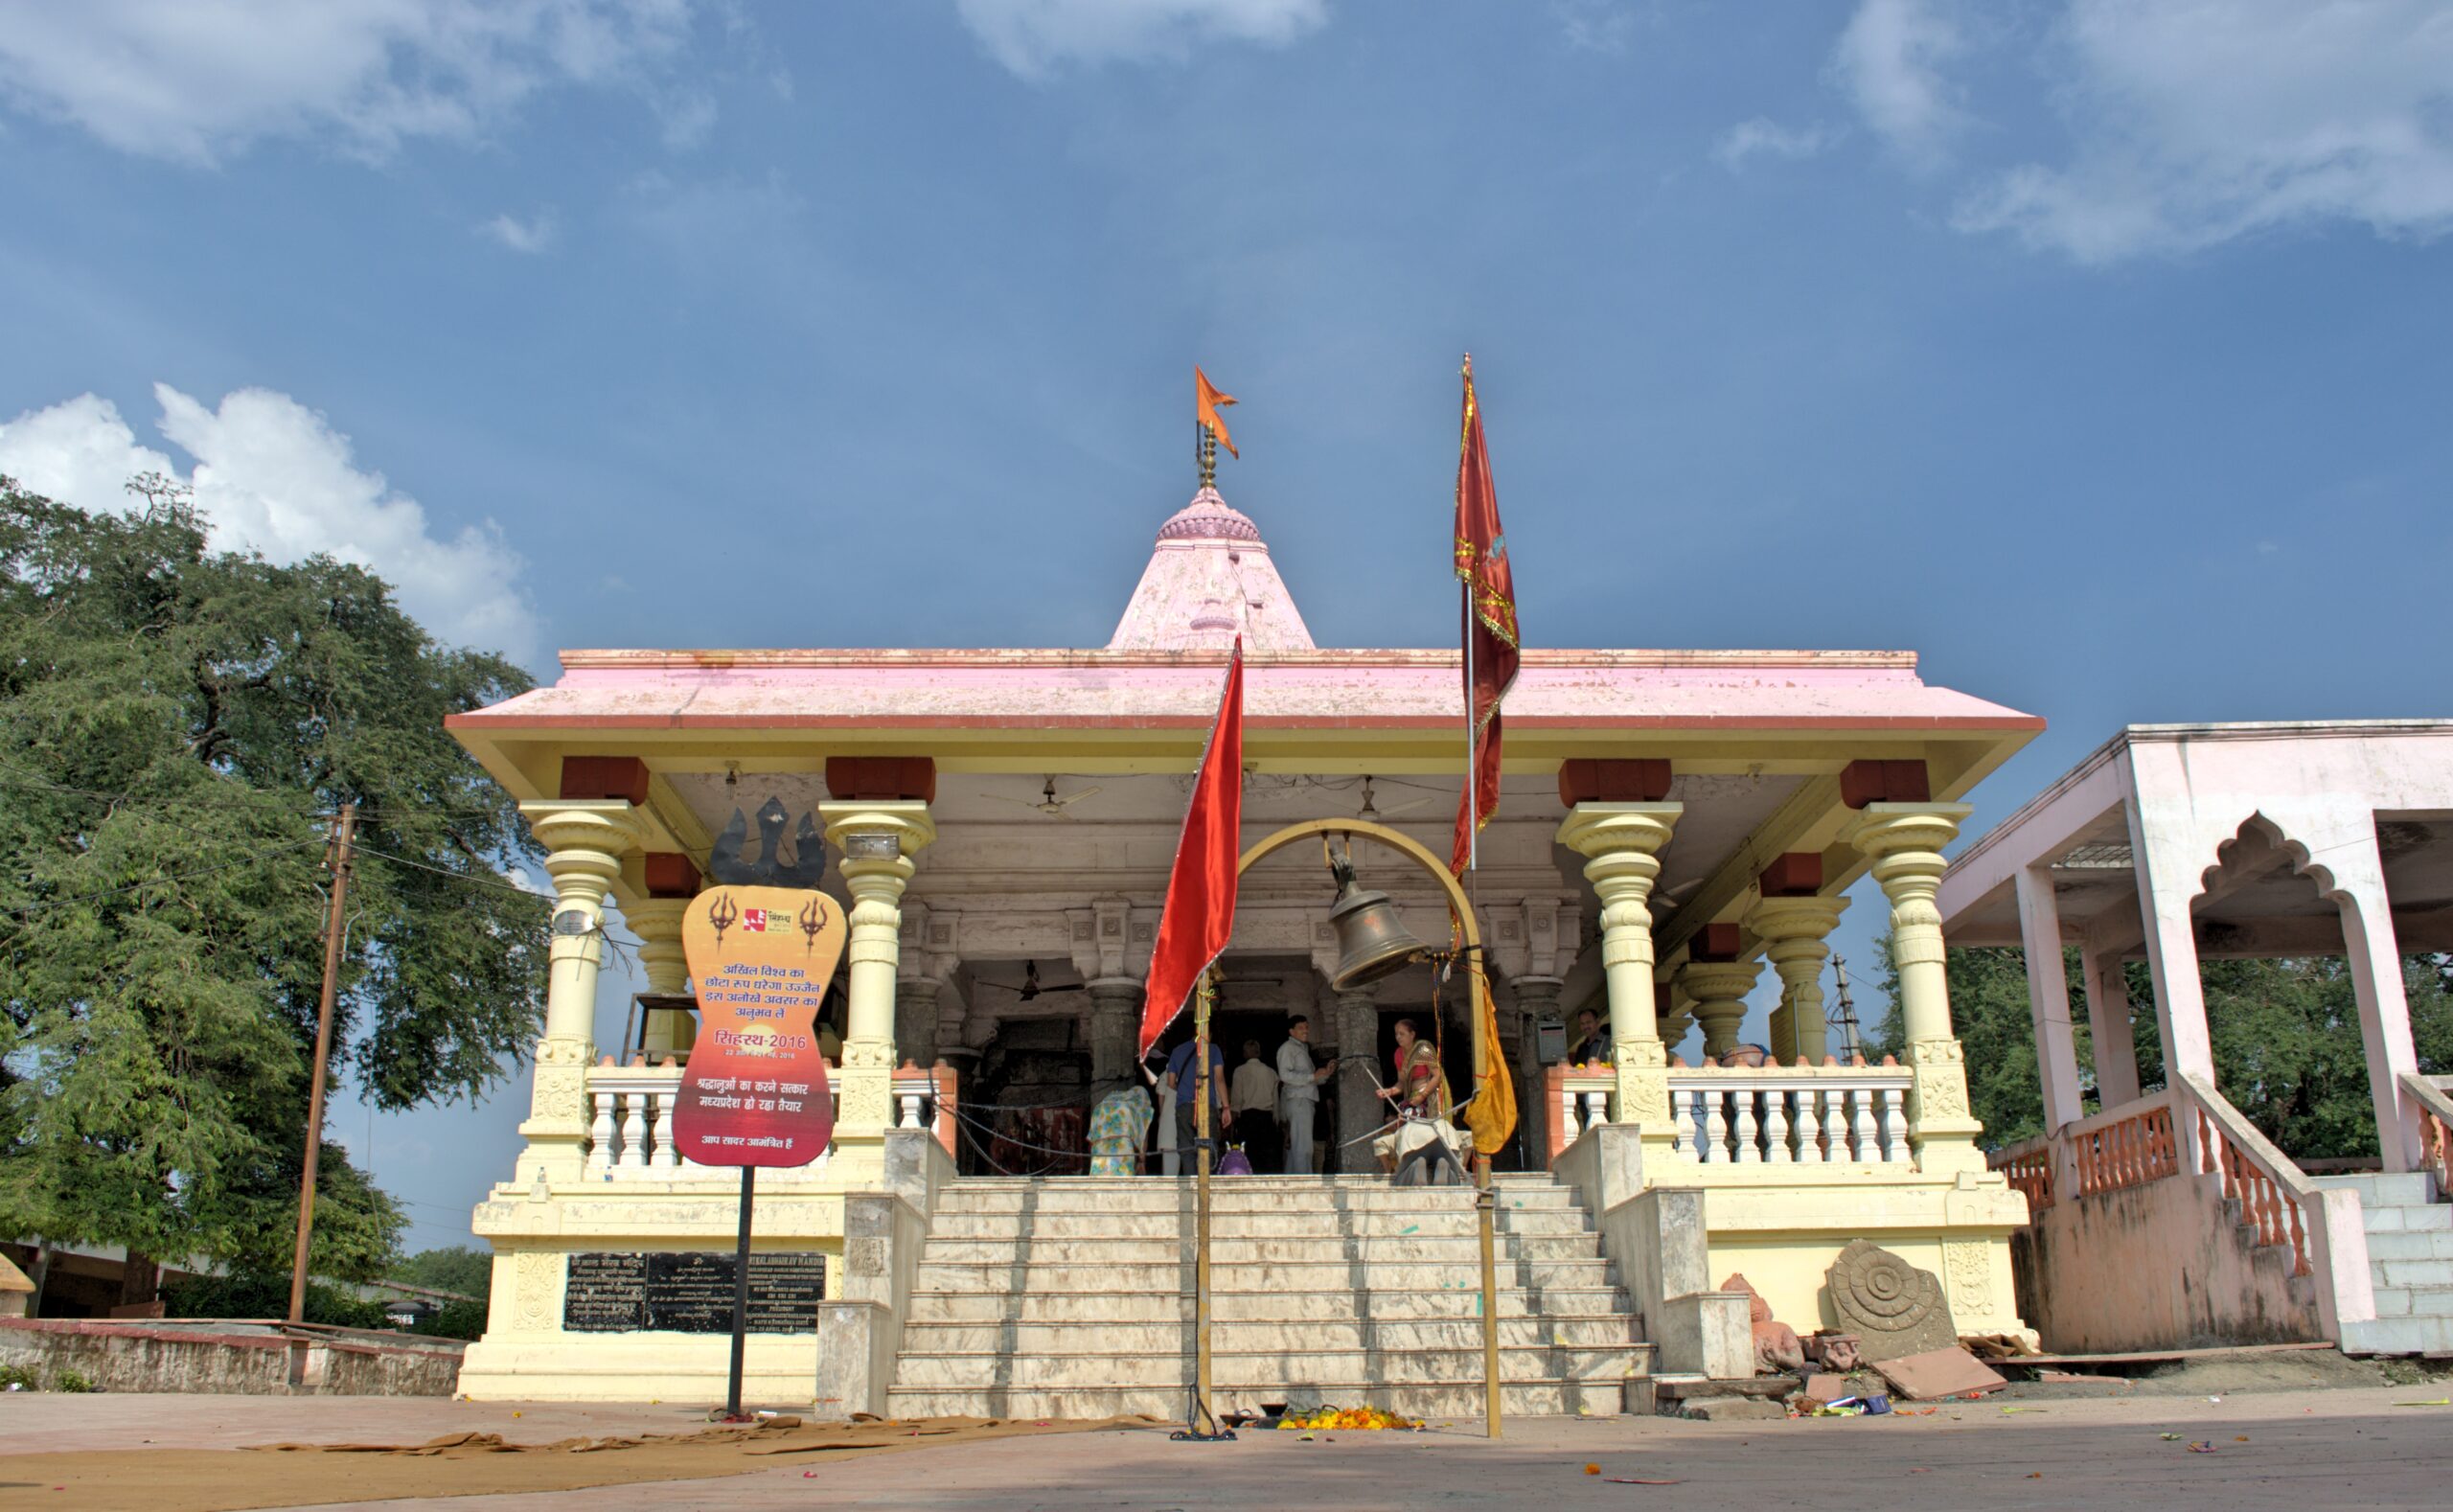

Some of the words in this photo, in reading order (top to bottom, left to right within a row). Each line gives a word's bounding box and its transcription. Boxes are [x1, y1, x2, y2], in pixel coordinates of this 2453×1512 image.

[723, 964, 758, 975] अखिल
[761, 965, 786, 977] विश्व
[790, 969, 804, 978] का
[705, 976, 729, 988] छोटा
[733, 979, 750, 989] रूप
[753, 979, 782, 991] धरेगा
[786, 981, 820, 993] उज्जैन
[705, 992, 722, 1001] इस
[727, 993, 761, 1002] अनोखे
[765, 996, 799, 1005] अवसर
[803, 997, 817, 1006] का
[736, 1007, 771, 1020] अनुभव
[775, 1008, 785, 1018] लें
[715, 1029, 806, 1049] सिंहस्थ-2016
[697, 1077, 736, 1094] श्रद्धालुओं
[740, 1080, 751, 1091] का
[755, 1079, 776, 1092] करने
[780, 1083, 809, 1094] सत्कार
[699, 1094, 741, 1109] मध्यप्रदेश
[744, 1095, 755, 1110] हो
[759, 1099, 774, 1111] रहा
[778, 1097, 802, 1111] तैयार
[701, 1135, 720, 1144] आप
[722, 1136, 745, 1146] सादर
[746, 1136, 783, 1148] आमंत्रित
